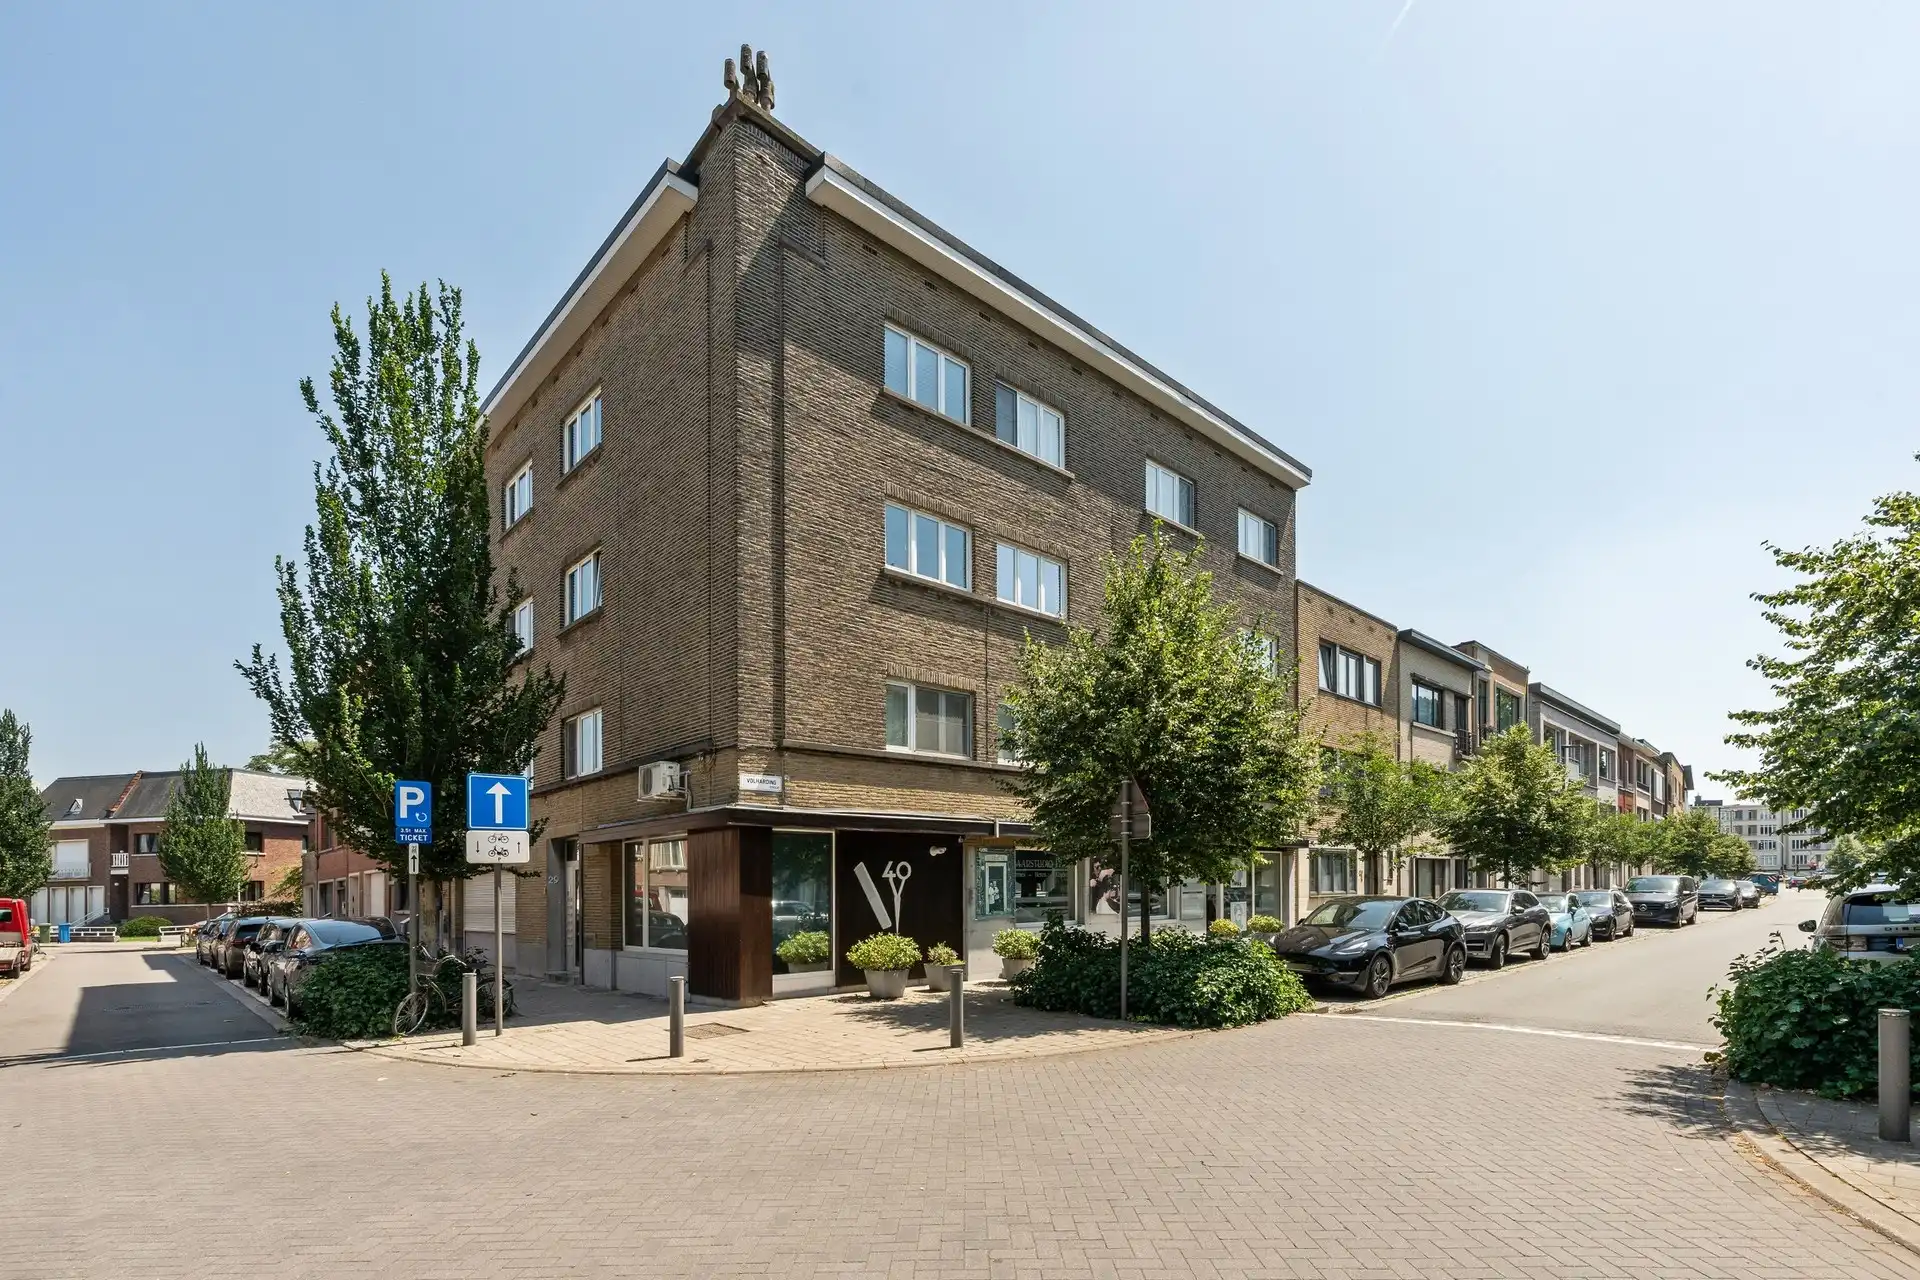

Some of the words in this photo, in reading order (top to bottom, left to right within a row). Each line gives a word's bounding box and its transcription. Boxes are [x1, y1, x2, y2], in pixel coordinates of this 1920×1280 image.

[746, 778, 777, 786] VOLHARDING
[399, 786, 425, 819] P
[399, 834, 429, 842] TICKET
[1016, 859, 1054, 868] AARSTUDIO
[548, 875, 560, 885] 29
